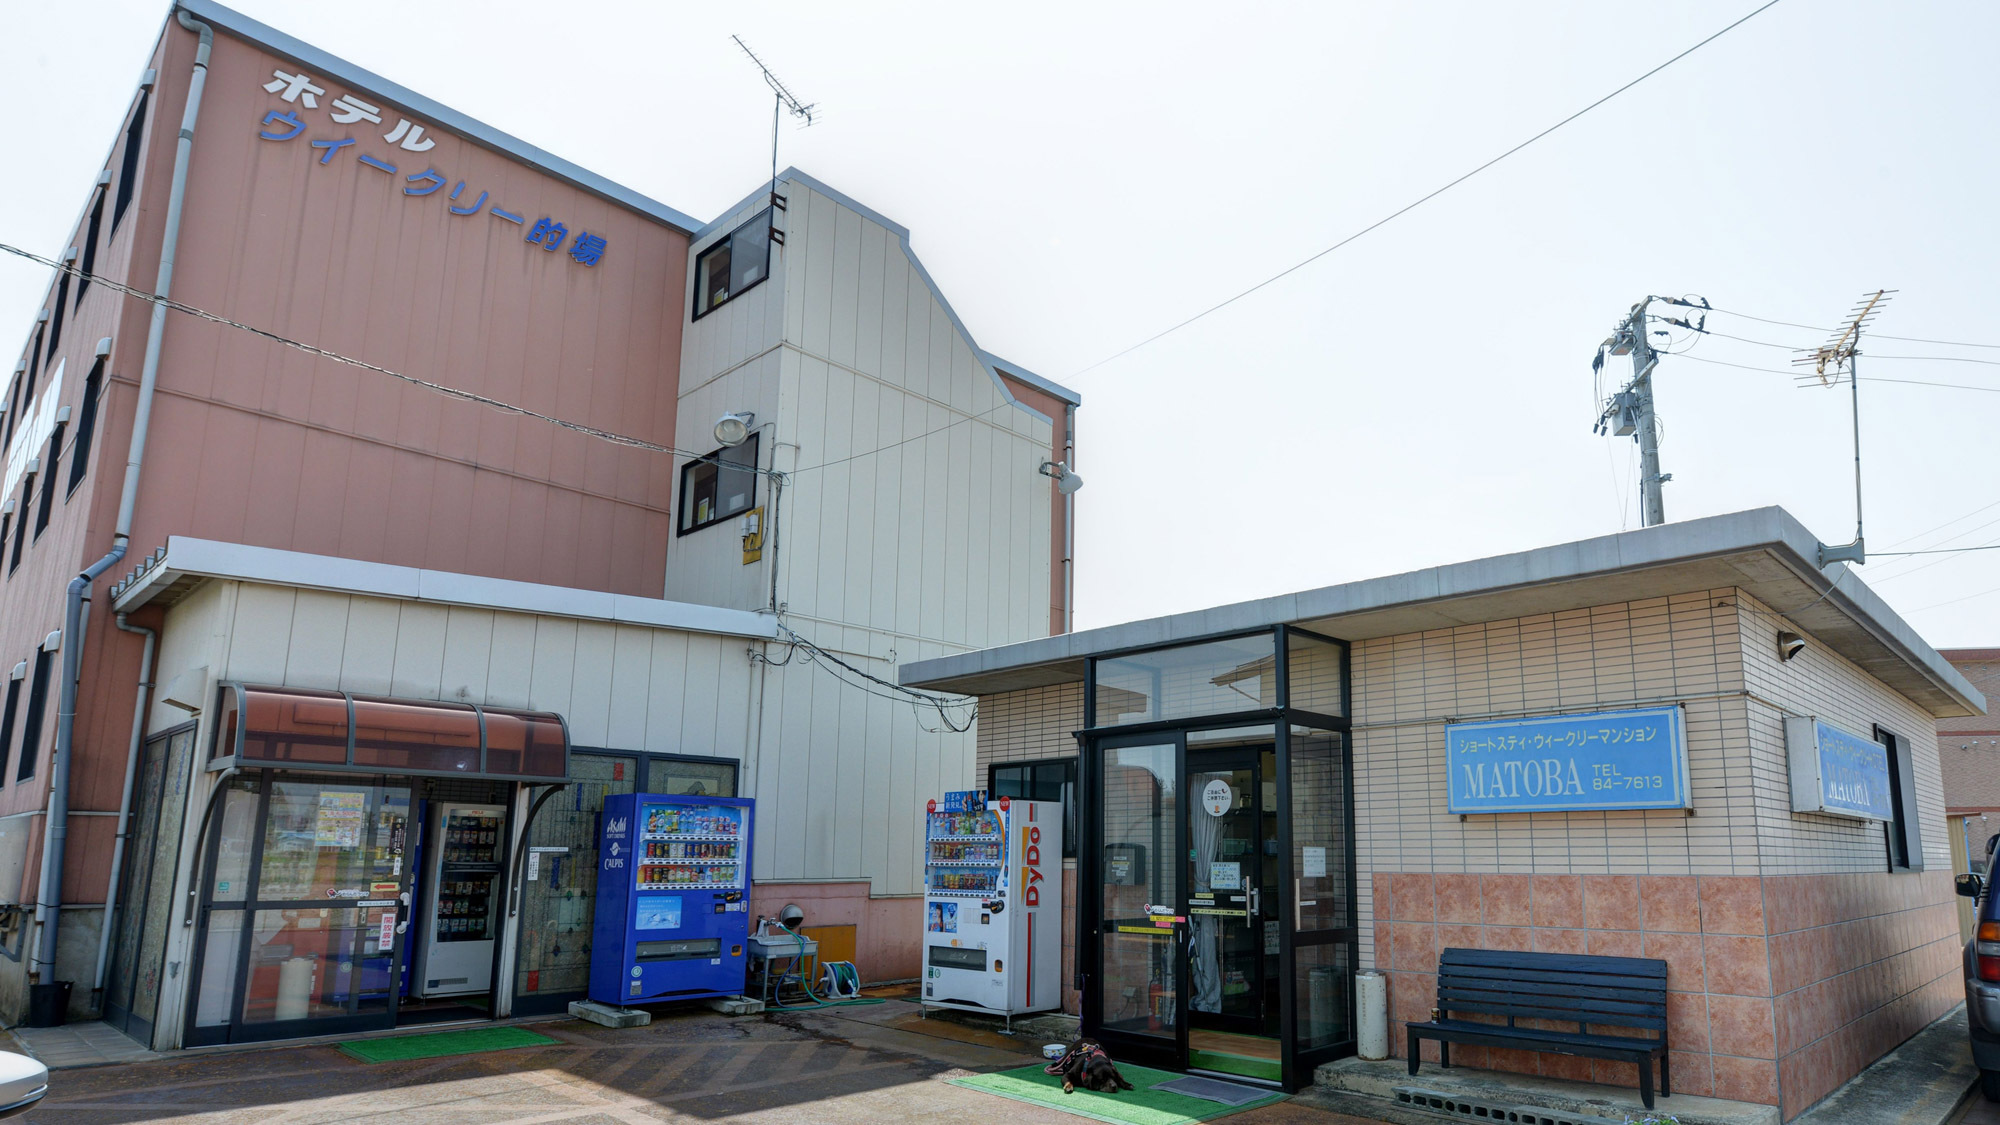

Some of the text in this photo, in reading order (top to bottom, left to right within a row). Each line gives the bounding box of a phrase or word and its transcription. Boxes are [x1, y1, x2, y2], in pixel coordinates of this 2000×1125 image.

[262, 69, 436, 152] ホテル
[1462, 757, 1586, 799] MATOBA
[1592, 764, 1622, 777] TEL
[1592, 775, 1663, 791] 84-7613
[1826, 761, 1871, 807] MATOBA
[945, 792, 961, 801] うまみ
[604, 858, 624, 871] CALPIS
